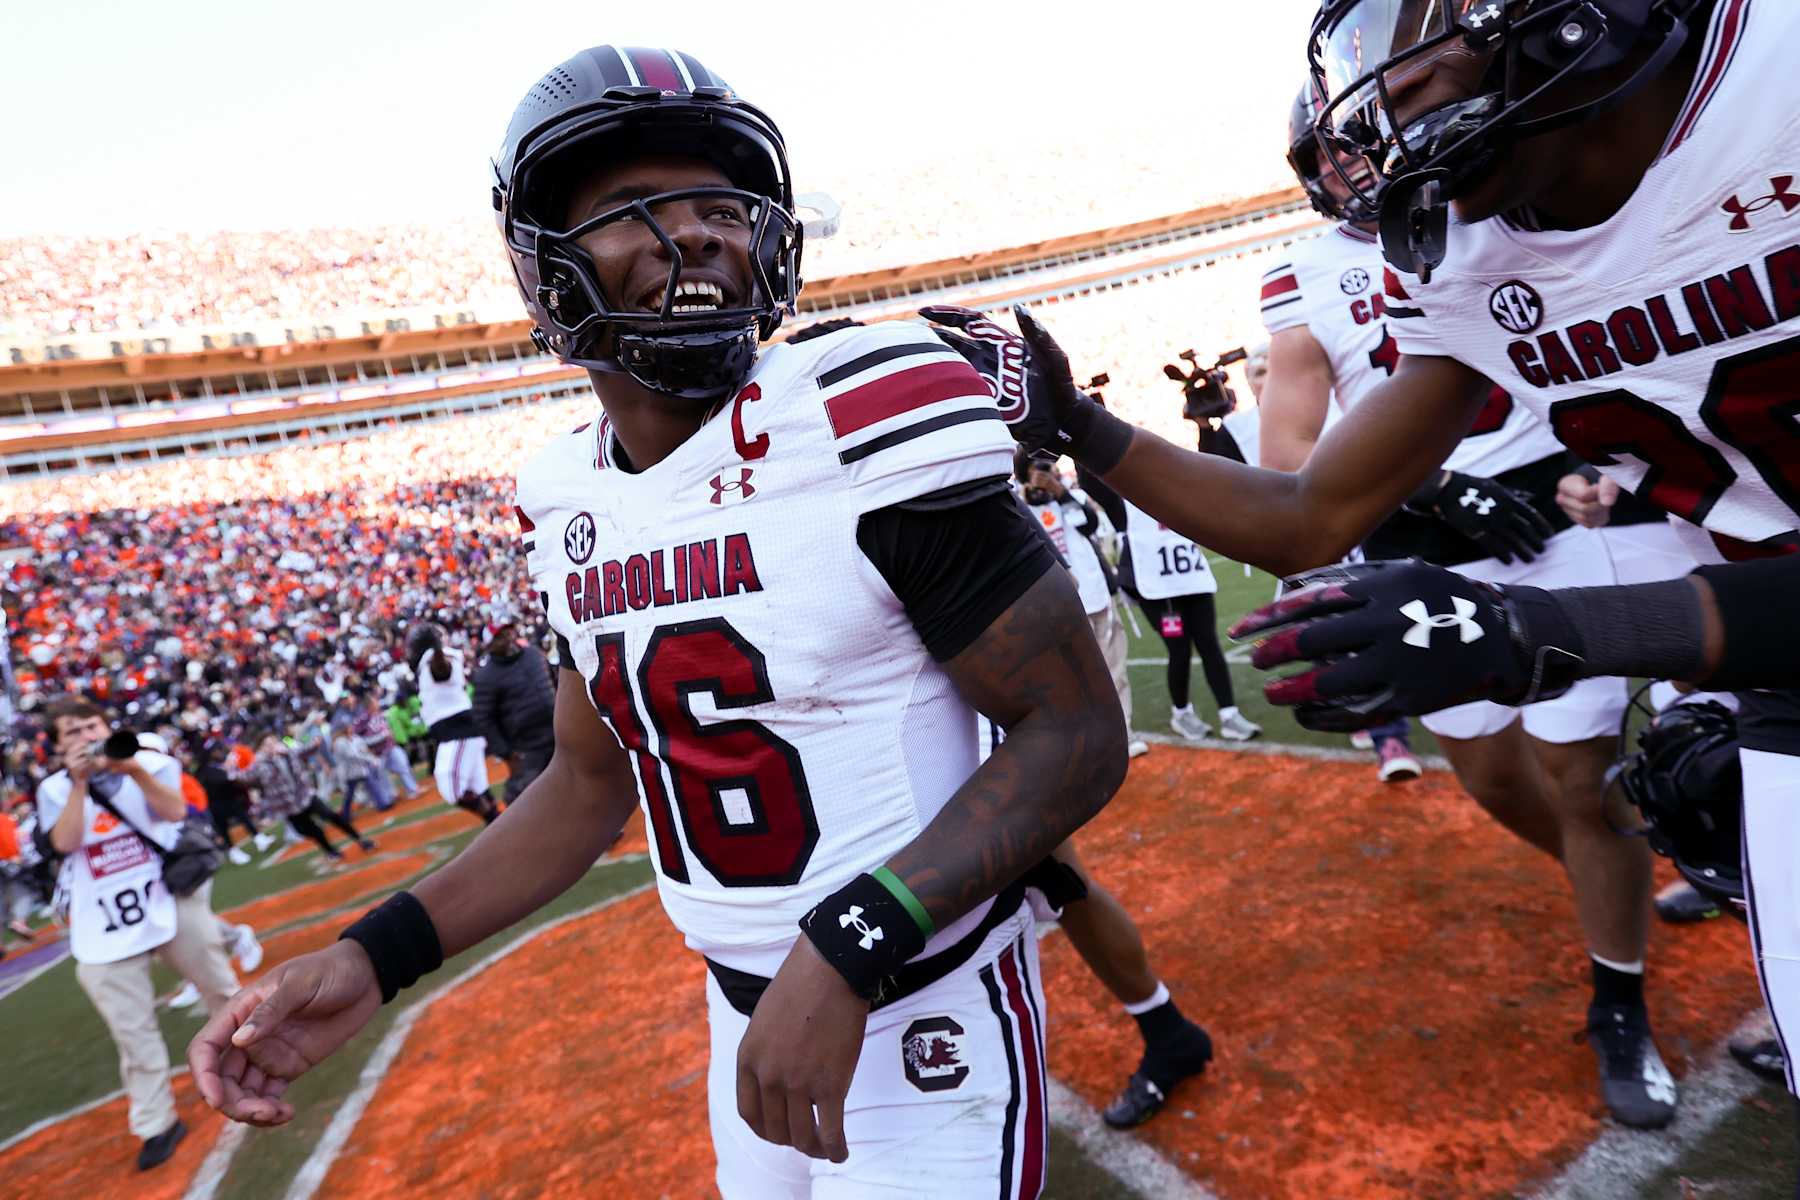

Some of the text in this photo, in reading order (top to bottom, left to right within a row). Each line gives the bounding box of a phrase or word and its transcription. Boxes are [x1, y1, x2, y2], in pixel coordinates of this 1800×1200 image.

[1493, 285, 1540, 329] SEC
[1507, 244, 1800, 388] CAROLINA
[731, 381, 771, 461] C
[565, 532, 764, 624] CAROLINA
[567, 516, 594, 560] SEC
[590, 616, 821, 888] 16
